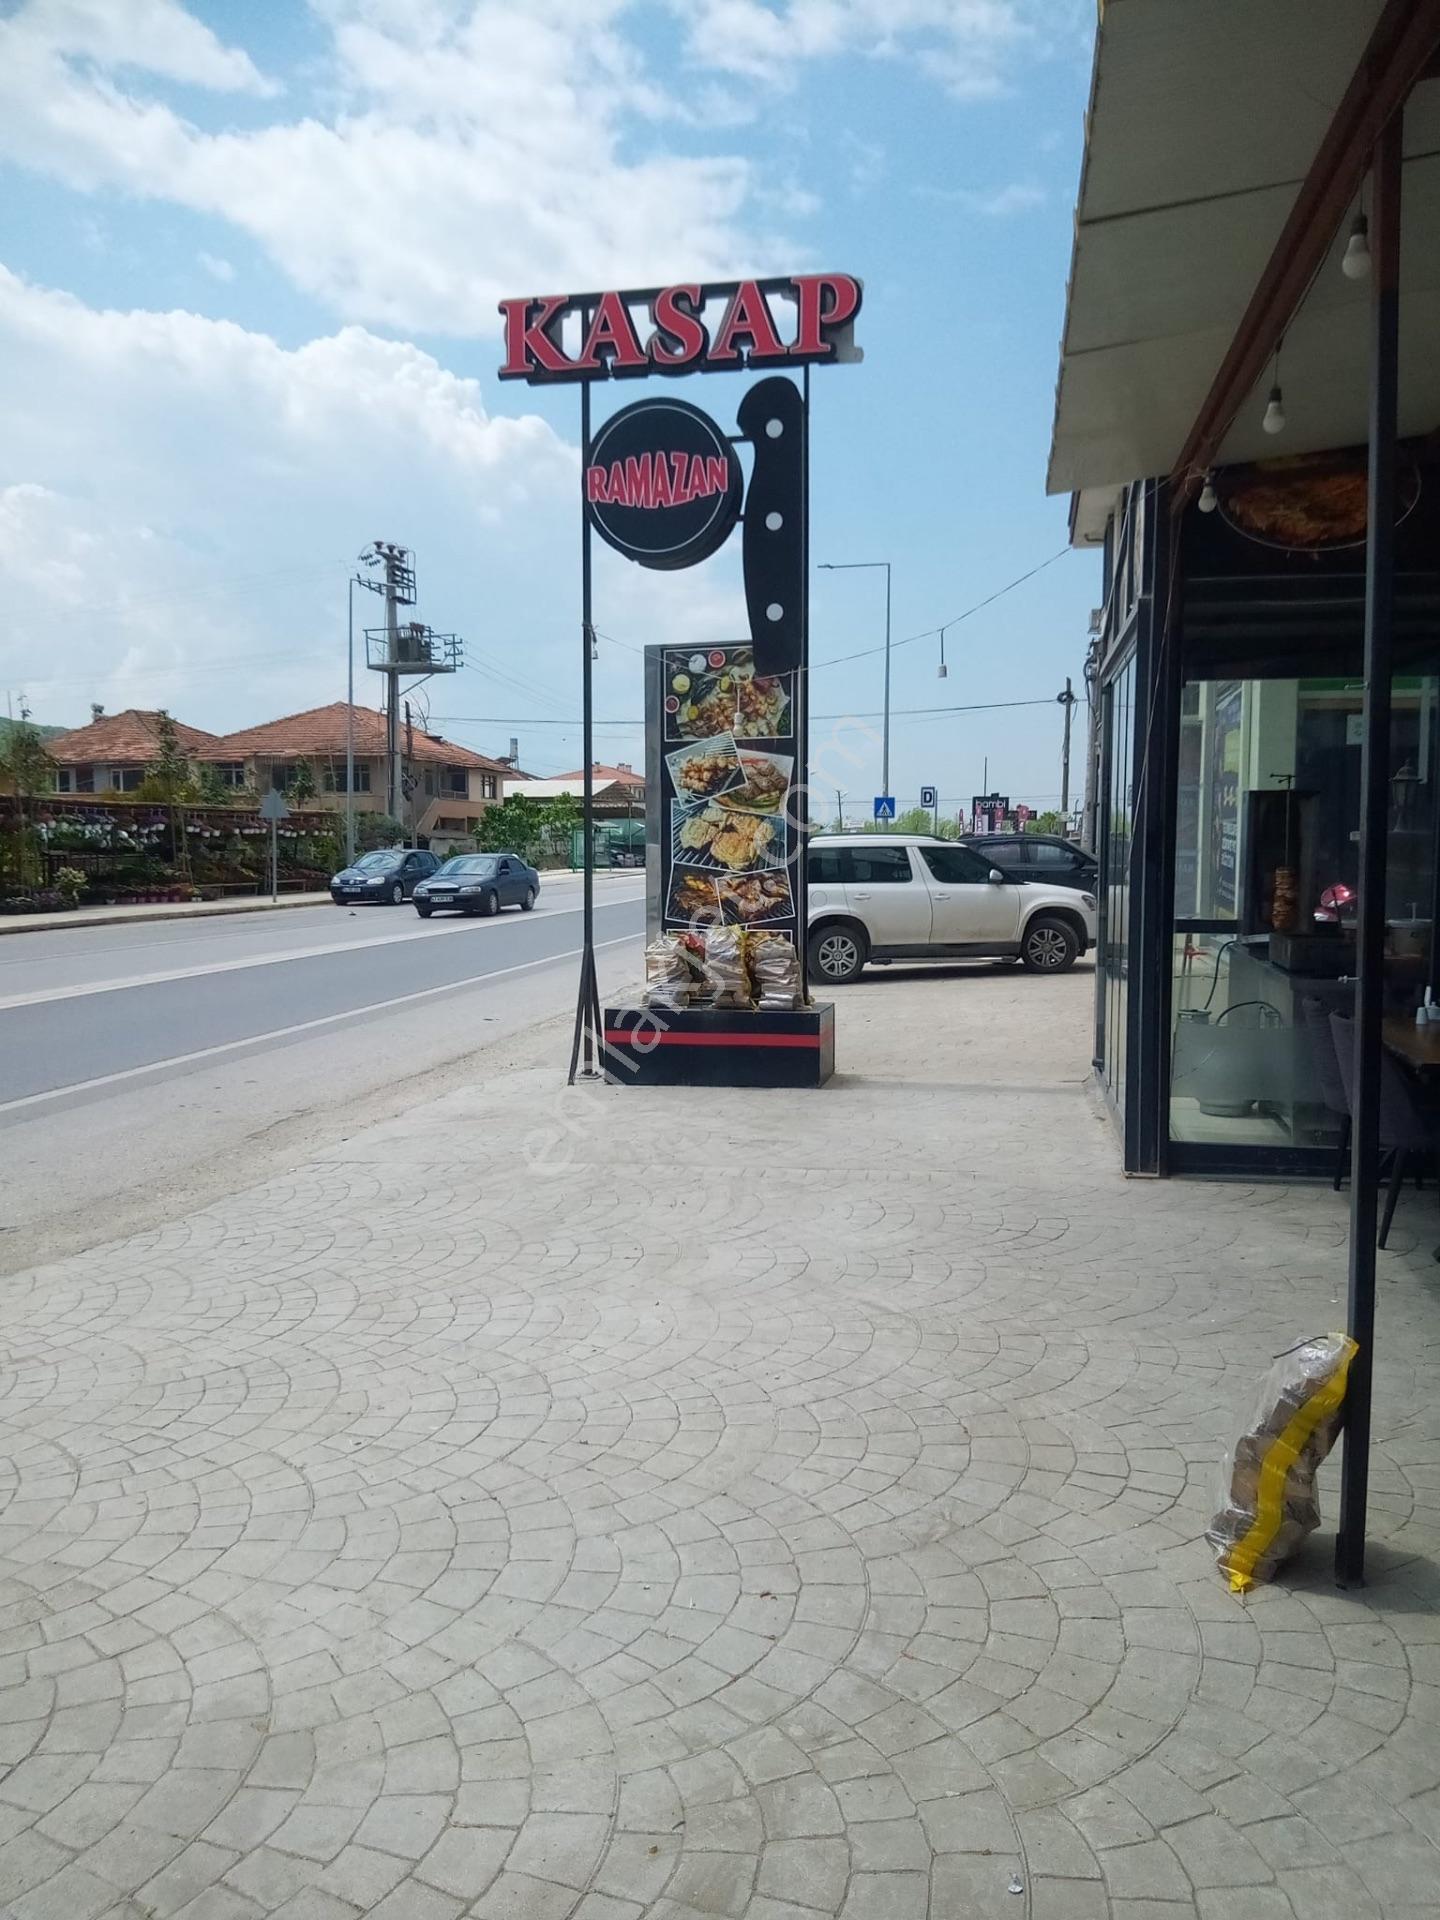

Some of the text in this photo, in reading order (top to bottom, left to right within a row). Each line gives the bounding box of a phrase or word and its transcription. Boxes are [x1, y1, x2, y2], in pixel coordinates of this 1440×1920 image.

[499, 274, 860, 374] KASAP
[587, 451, 728, 508] RAMAZAN
[923, 791, 933, 803] D
